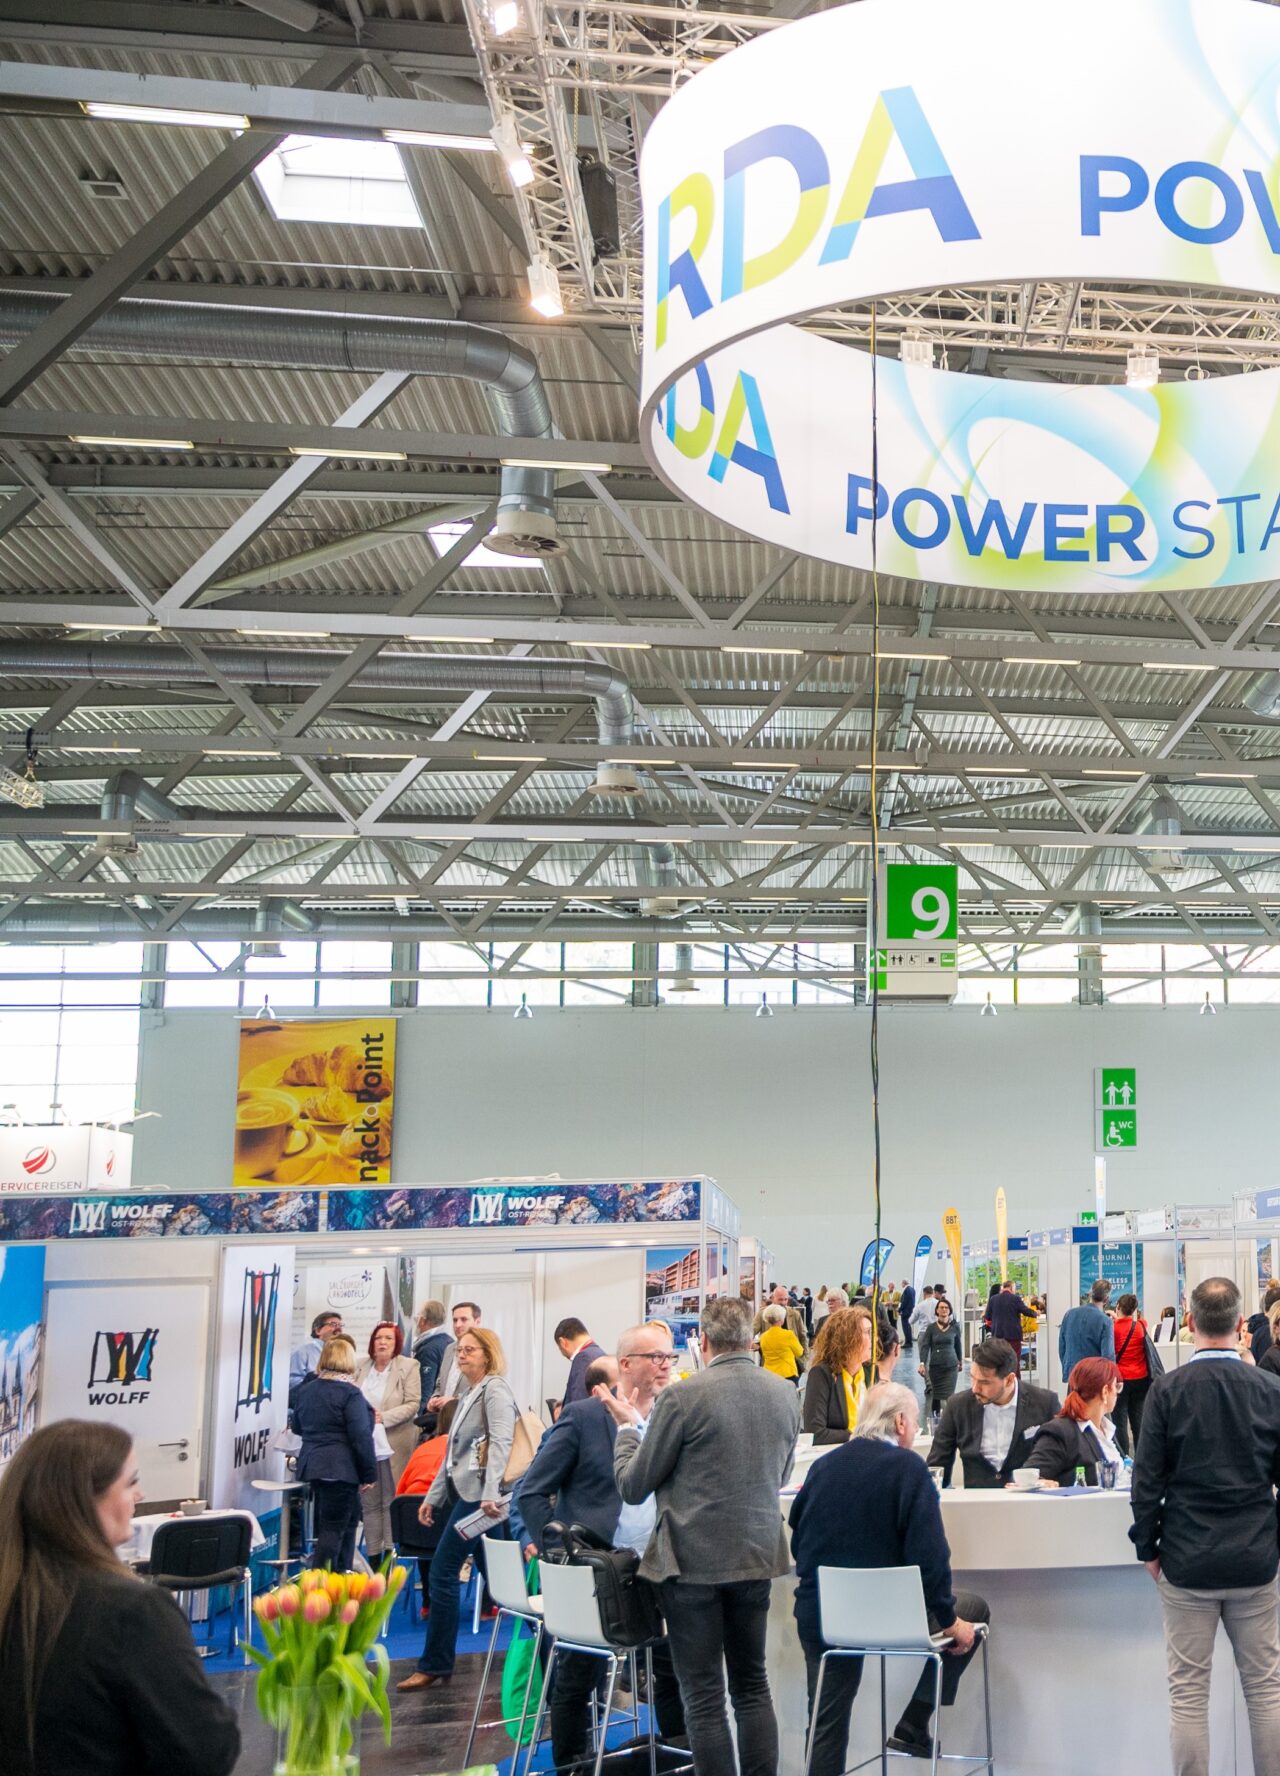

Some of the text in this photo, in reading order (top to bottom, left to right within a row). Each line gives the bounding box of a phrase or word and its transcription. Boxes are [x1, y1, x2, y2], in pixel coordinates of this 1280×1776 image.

[656, 85, 981, 351] RDA
[657, 360, 791, 515] DA
[846, 472, 1146, 563] POWER
[911, 886, 950, 940] 9
[356, 1032, 384, 1103] Point
[1119, 1121, 1134, 1129] WC
[111, 1204, 174, 1219] WOLFF
[508, 1196, 565, 1210] WOLFF
[945, 1216, 957, 1224] BBT
[88, 1391, 150, 1406] WOLFF
[233, 1428, 271, 1469] WOLFF
